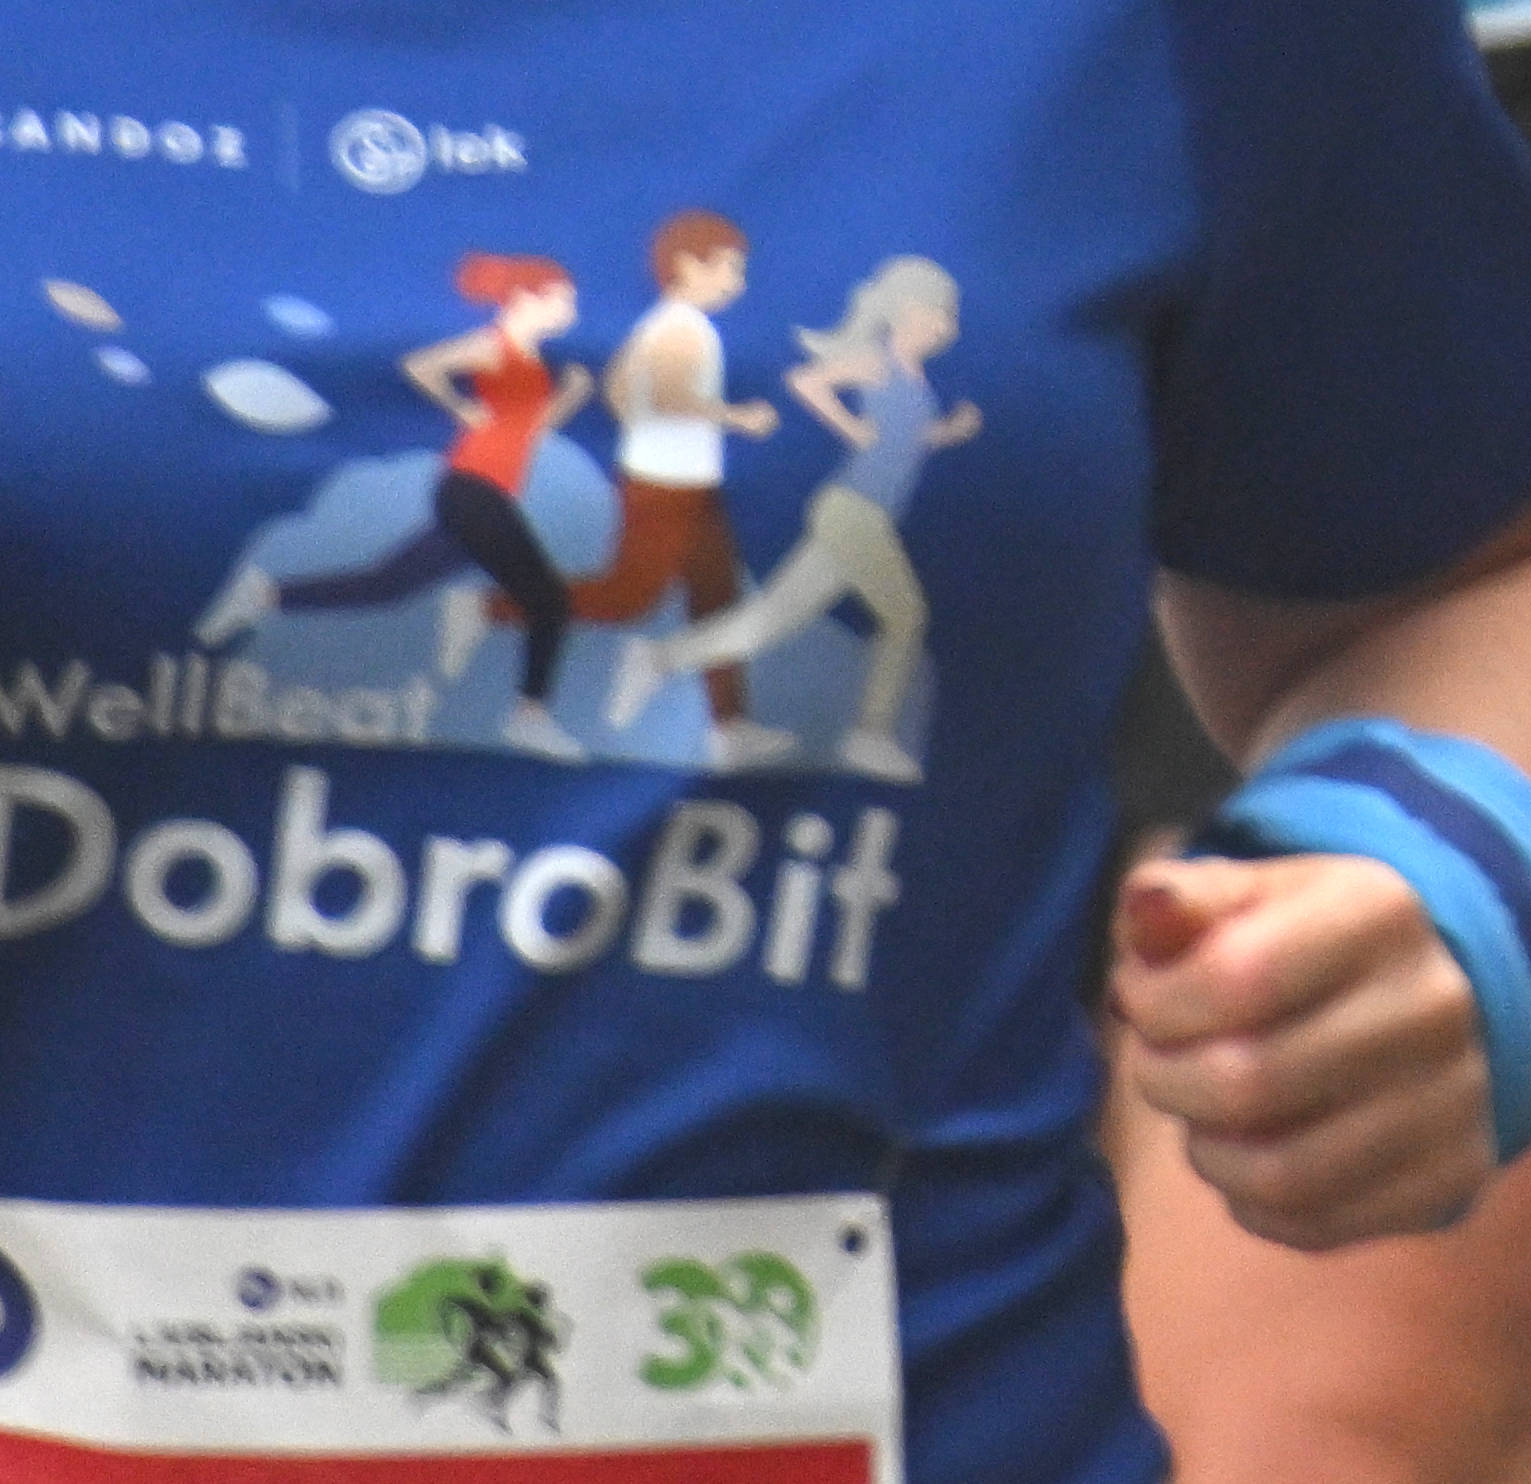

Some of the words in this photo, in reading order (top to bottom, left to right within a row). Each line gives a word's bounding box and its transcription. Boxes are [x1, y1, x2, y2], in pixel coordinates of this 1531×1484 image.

[3, 107, 248, 169] ANDOZ
[0, 650, 437, 744] WellBeat
[0, 762, 901, 992] DobroBit
